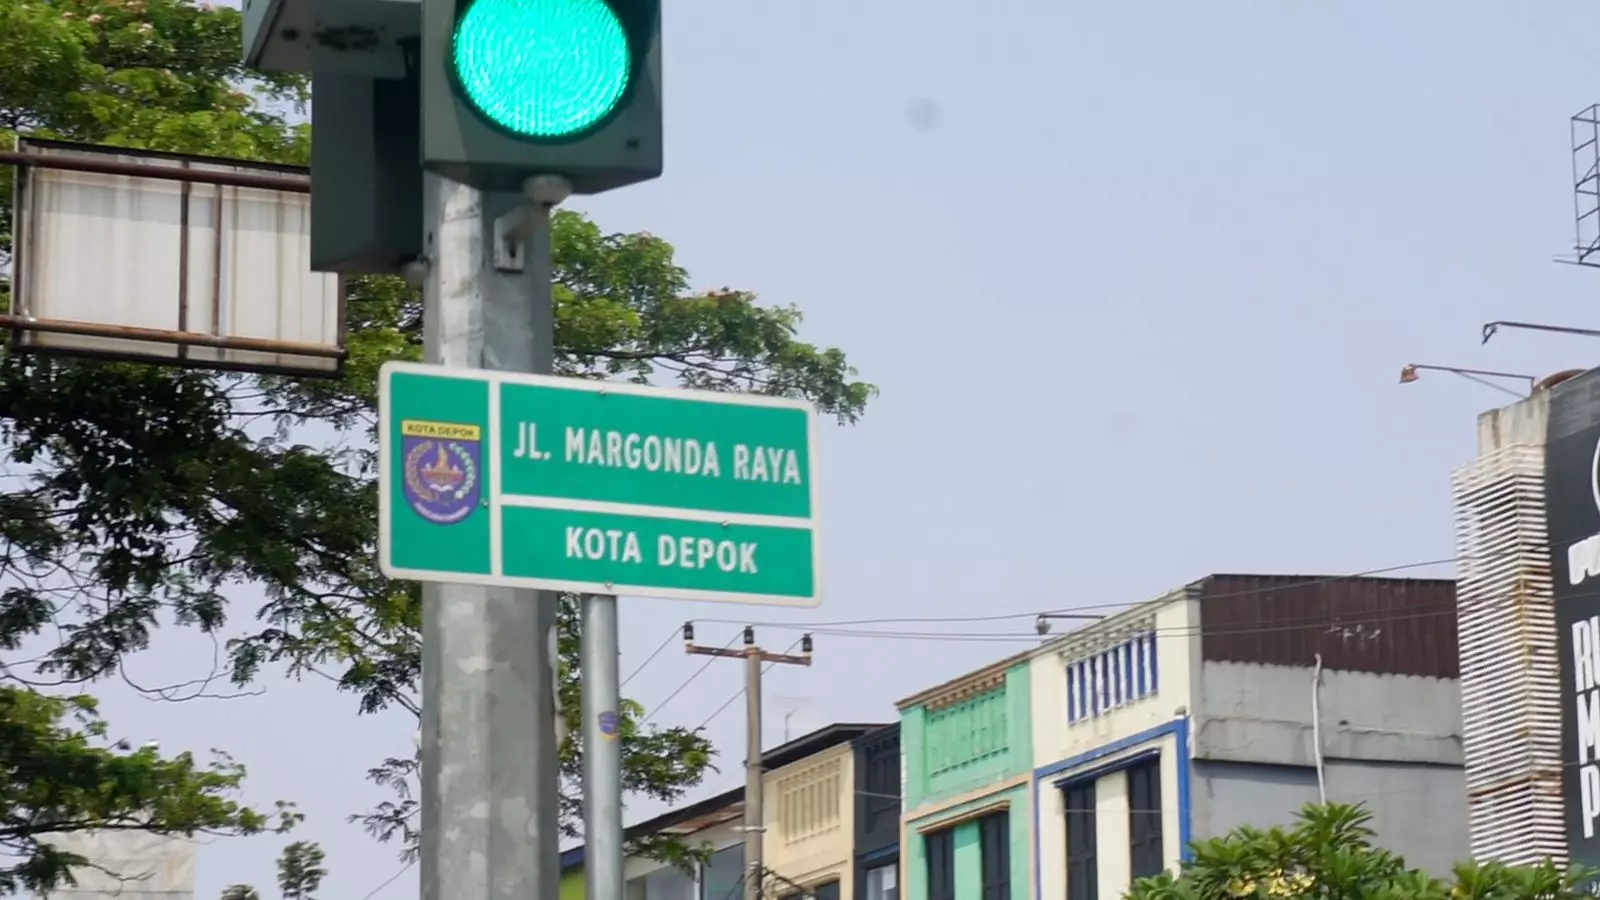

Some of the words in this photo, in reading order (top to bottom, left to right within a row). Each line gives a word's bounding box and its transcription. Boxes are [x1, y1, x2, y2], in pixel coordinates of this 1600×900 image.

[406, 422, 436, 433] KOTA
[513, 421, 551, 461] JL.
[565, 427, 721, 478] MARGONDA
[734, 443, 801, 485] RAYA
[566, 526, 642, 565] KOTA
[658, 533, 758, 575] DEPOK
